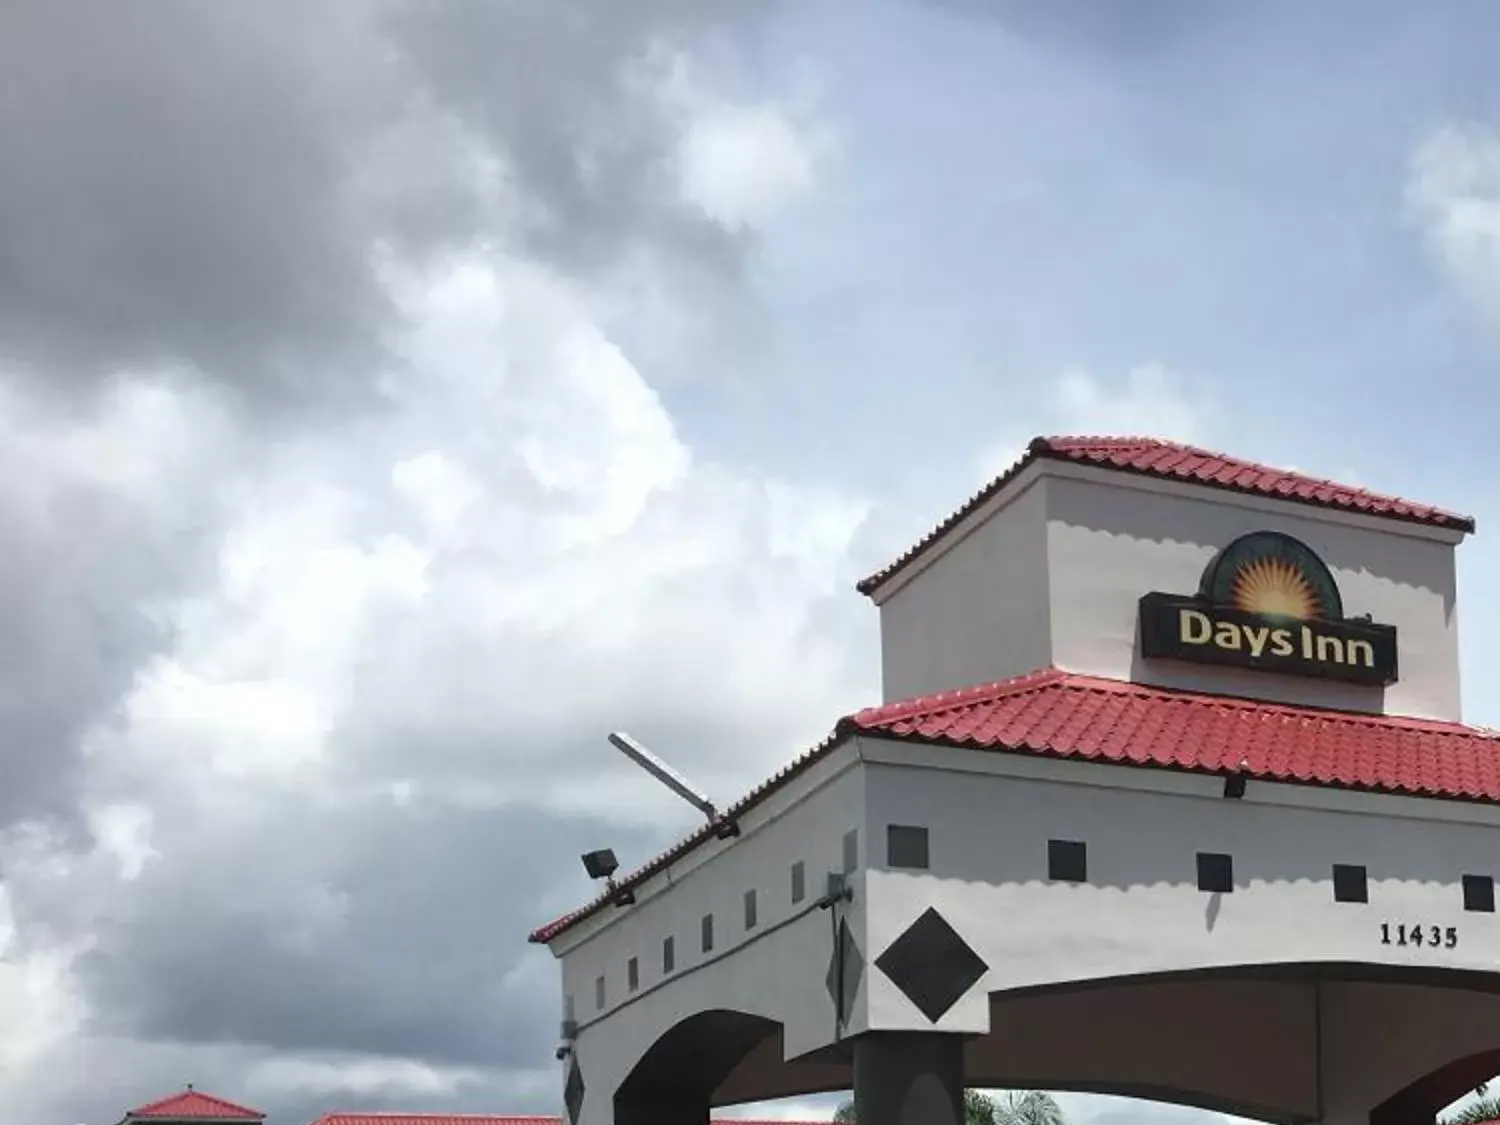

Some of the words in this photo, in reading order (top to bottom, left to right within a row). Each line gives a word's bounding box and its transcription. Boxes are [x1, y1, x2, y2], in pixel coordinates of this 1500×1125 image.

[1179, 608, 1294, 657] Days
[1302, 626, 1375, 667] Inn
[1381, 923, 1457, 949] 11435
